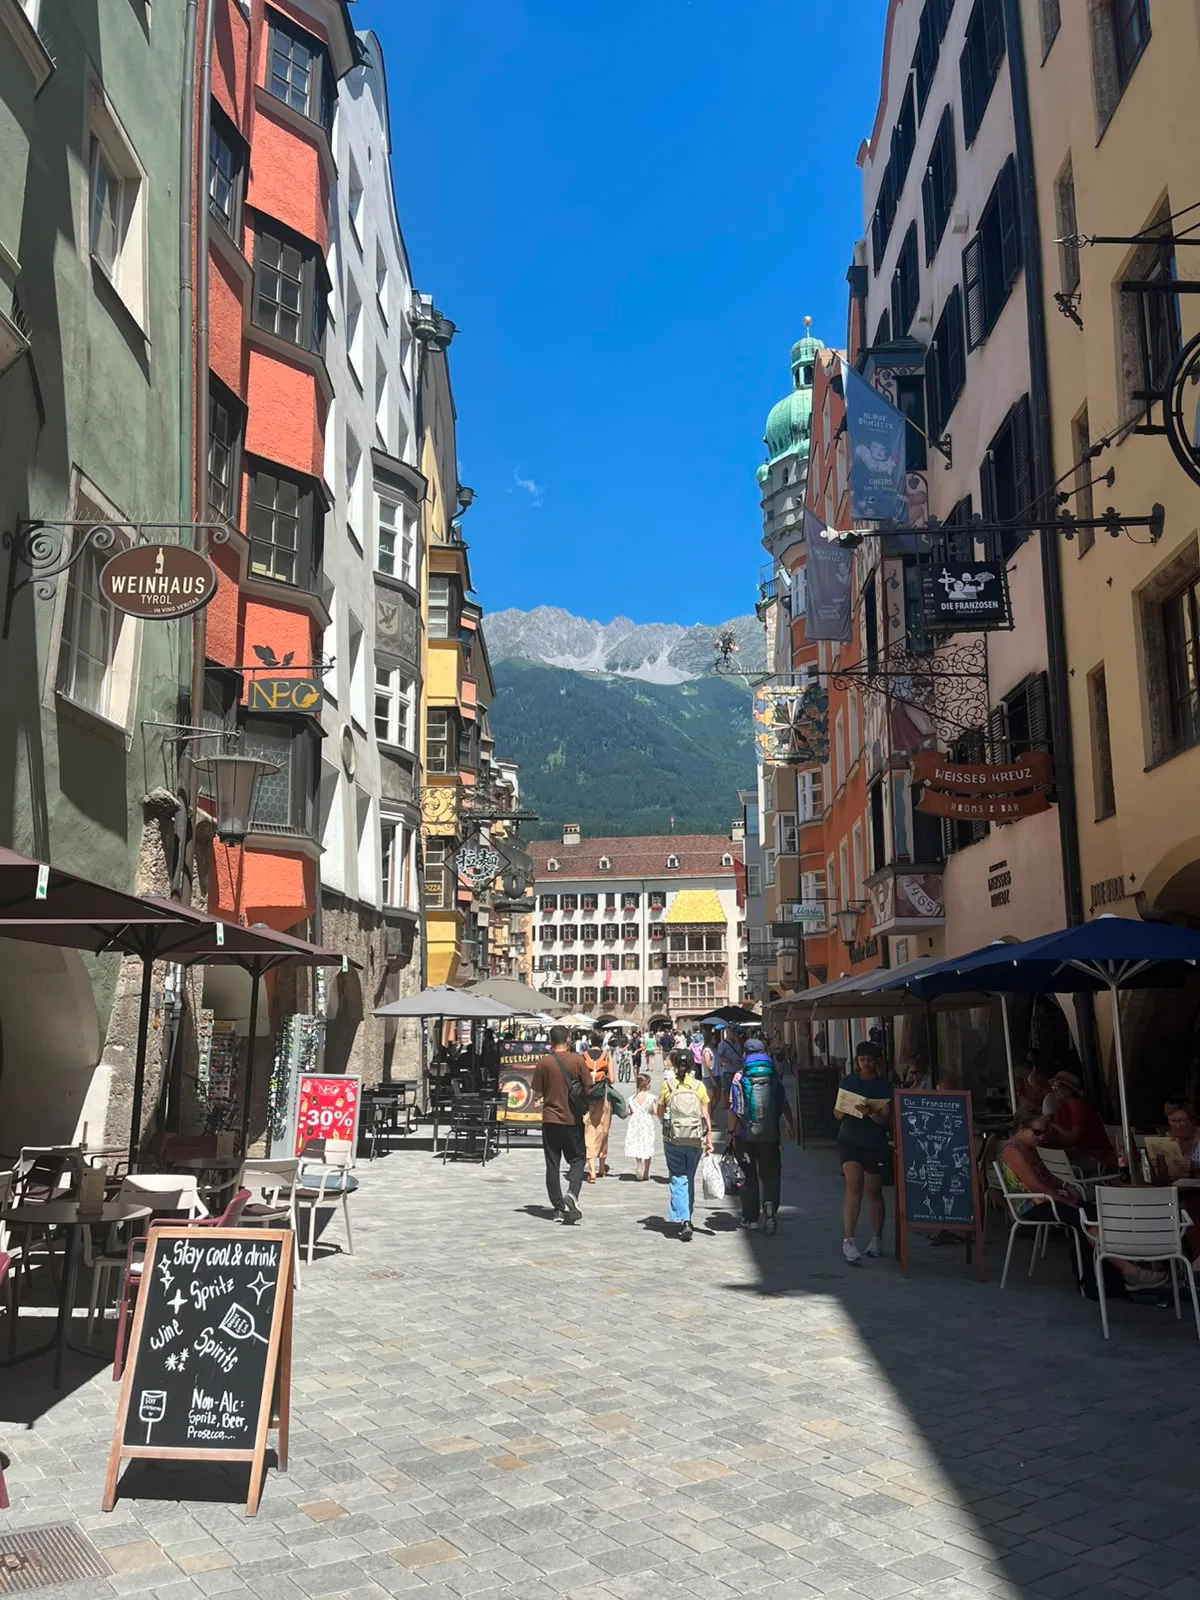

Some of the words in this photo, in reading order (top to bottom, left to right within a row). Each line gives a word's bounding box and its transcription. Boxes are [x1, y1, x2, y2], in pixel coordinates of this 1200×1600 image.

[111, 575, 205, 594] WEINHAUS
[140, 594, 172, 605] TYROL
[176, 597, 200, 611] VERITAS
[940, 602, 954, 611] DIE
[955, 600, 999, 610] FRANZOSEN
[250, 681, 320, 709] NEO
[935, 768, 987, 784] WEISSES
[991, 767, 1032, 782] KREUZ
[950, 802, 984, 814] ROOMS
[1000, 803, 1019, 813] BAR
[424, 883, 442, 892] PIZZA
[318, 1084, 340, 1095] NEO
[173, 1239, 205, 1273] Stay
[206, 1243, 231, 1267] cool
[231, 1243, 243, 1267] &
[244, 1243, 278, 1267] drink
[190, 1275, 235, 1312] Spritz
[193, 1326, 239, 1373] Spirits
[191, 1388, 245, 1414] Non-Alc:
[188, 1410, 220, 1428] Spritz,
[221, 1413, 249, 1434] Beer,
